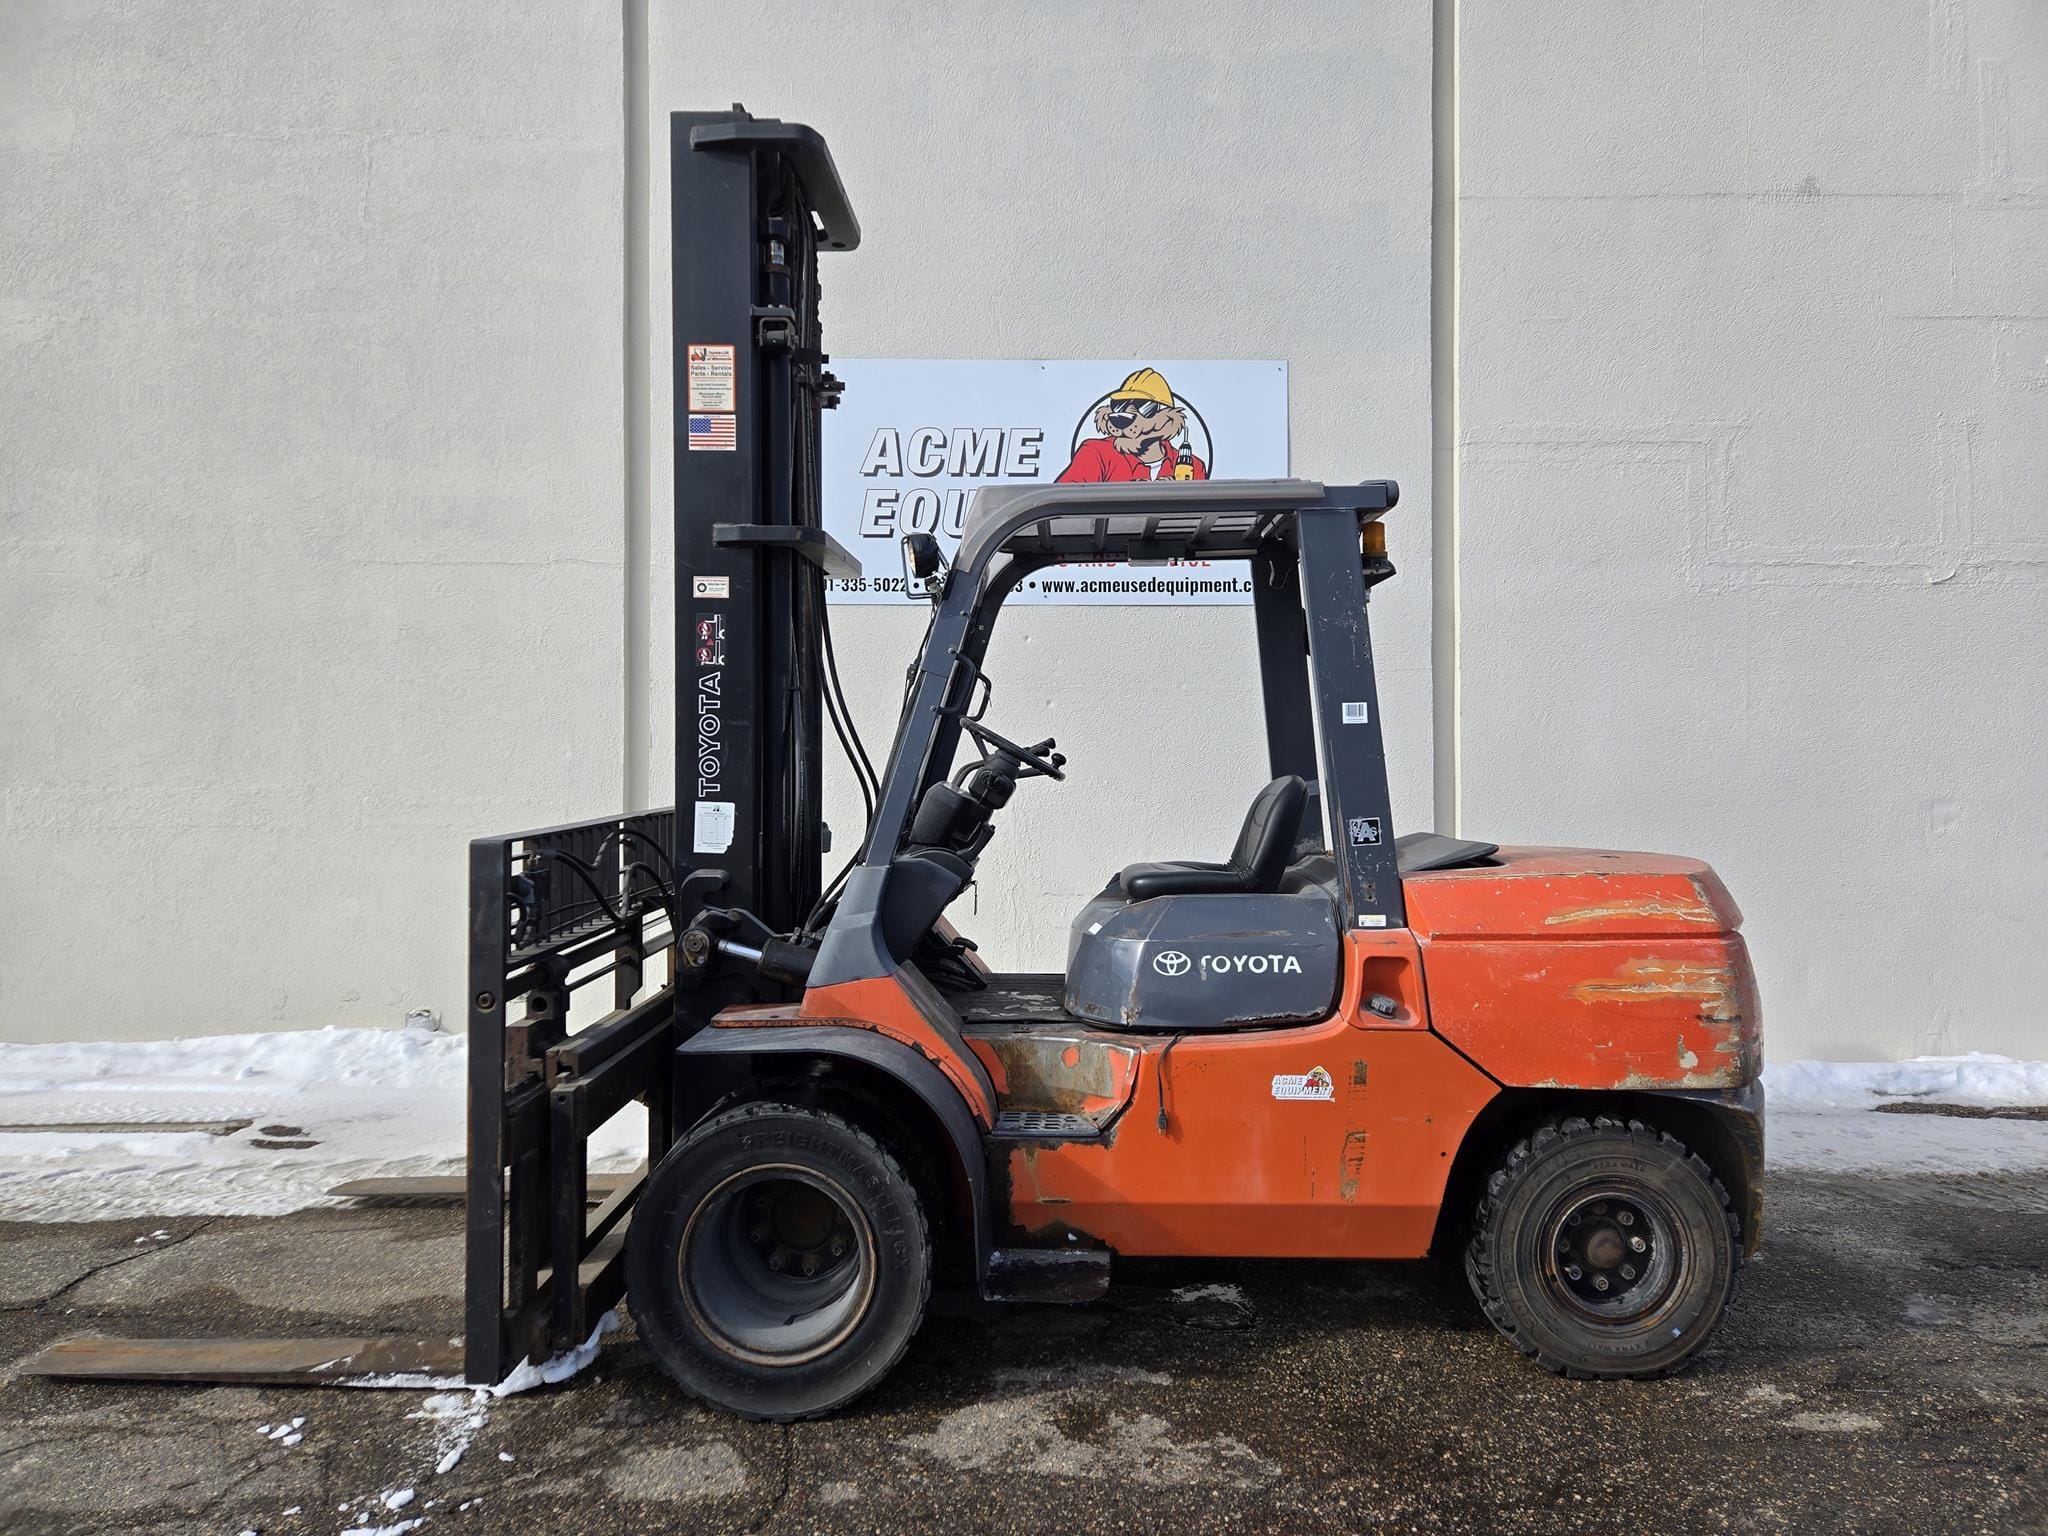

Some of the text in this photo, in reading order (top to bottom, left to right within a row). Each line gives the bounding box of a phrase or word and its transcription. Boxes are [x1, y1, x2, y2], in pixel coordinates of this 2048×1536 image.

[859, 427, 1044, 477] ACME
[699, 671, 721, 798] TOYOTA
[1274, 1077, 1304, 1086] ACME
[1274, 1086, 1332, 1096] EQUIPMENT
